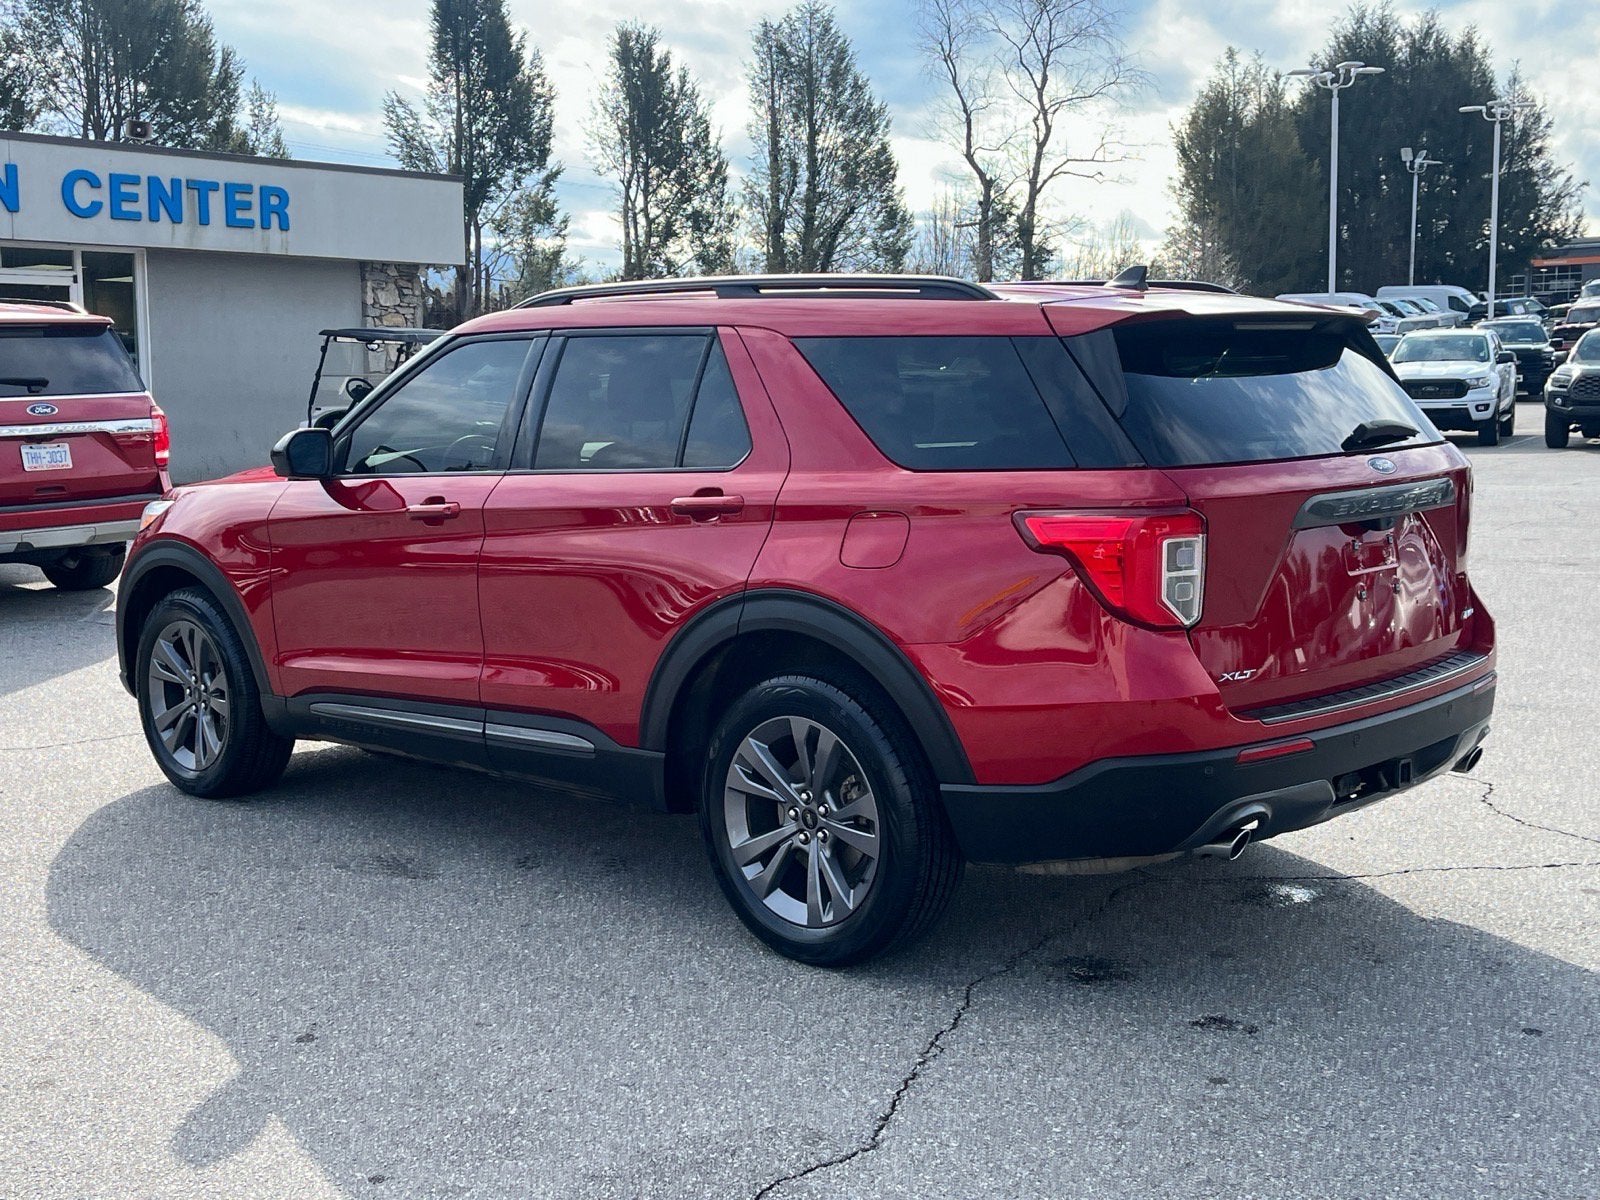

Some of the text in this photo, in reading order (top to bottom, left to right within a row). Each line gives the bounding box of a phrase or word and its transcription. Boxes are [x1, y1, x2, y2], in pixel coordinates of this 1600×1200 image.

[61, 169, 290, 231] CENTER
[34, 406, 52, 414] Ford
[24, 450, 68, 465] THH-3037
[1333, 486, 1442, 516] EXPLORER
[1218, 669, 1257, 682] XLT
